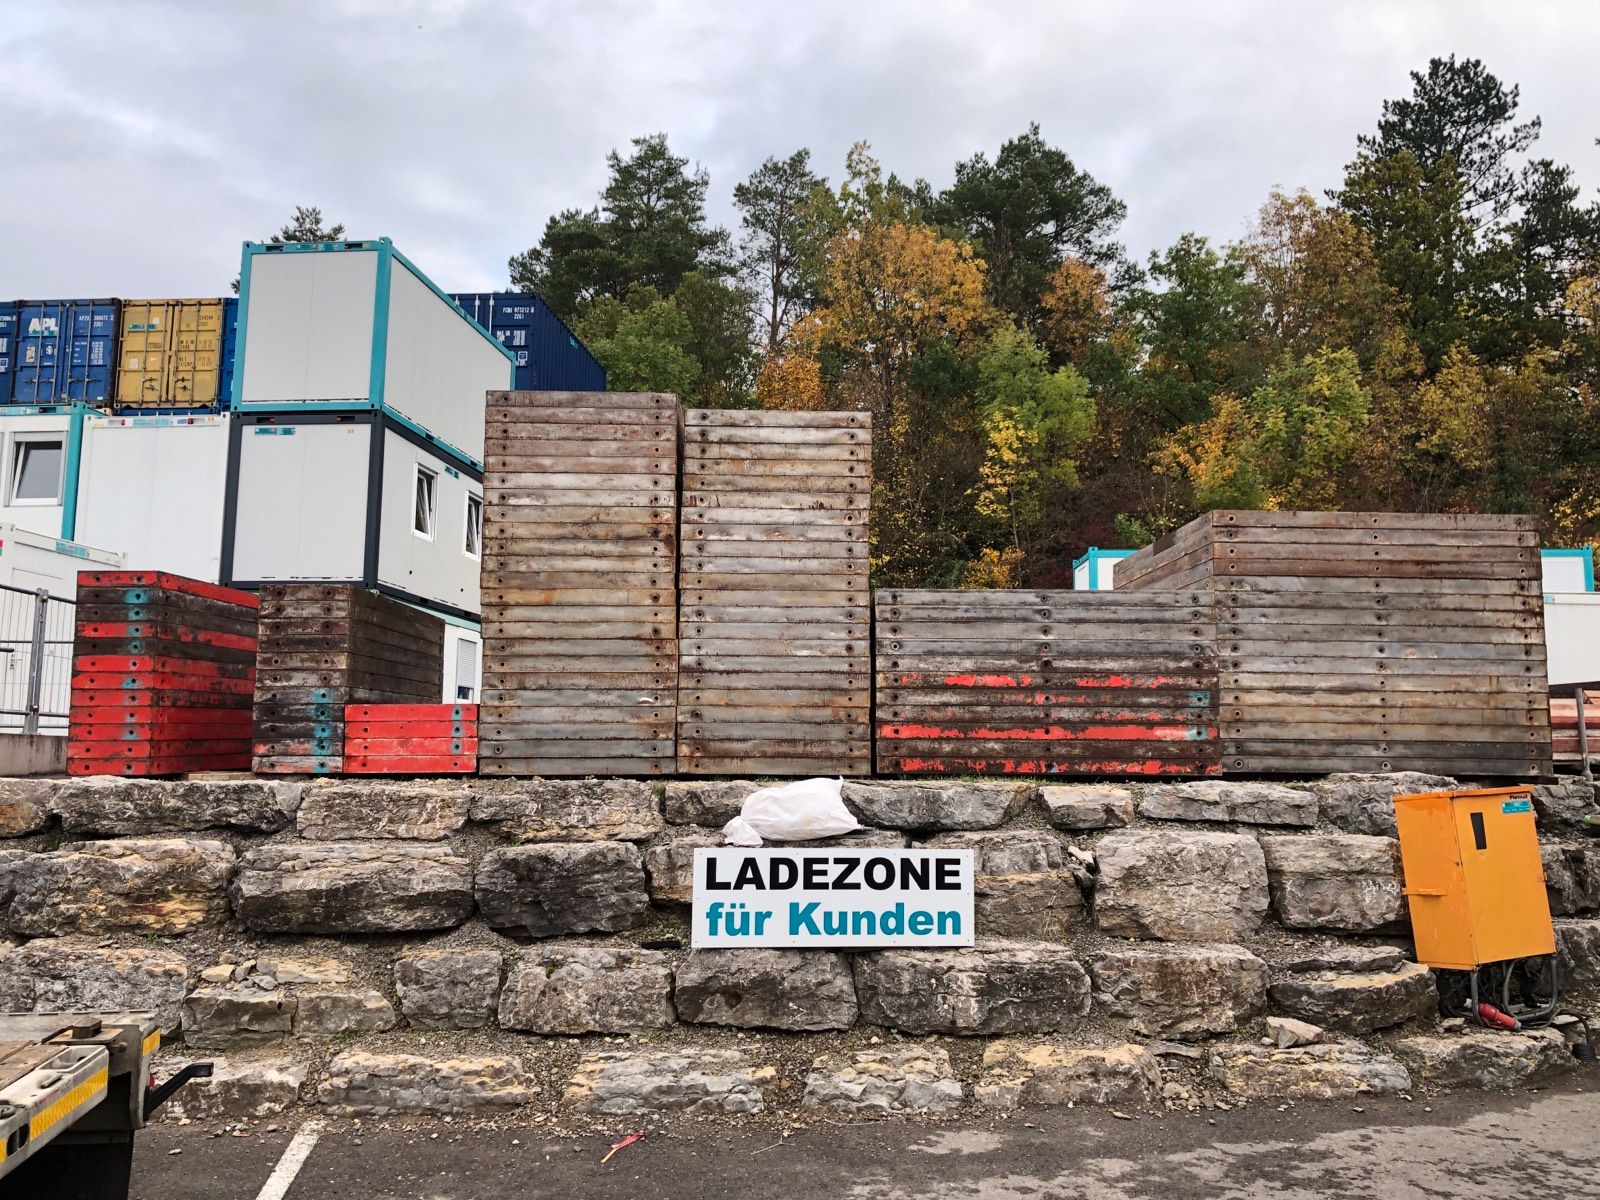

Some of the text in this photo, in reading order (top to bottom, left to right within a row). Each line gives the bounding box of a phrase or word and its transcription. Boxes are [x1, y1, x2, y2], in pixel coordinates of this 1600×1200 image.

[28, 317, 59, 332] APL
[705, 856, 962, 891] LADEZONE
[705, 901, 962, 937] für Kunden
